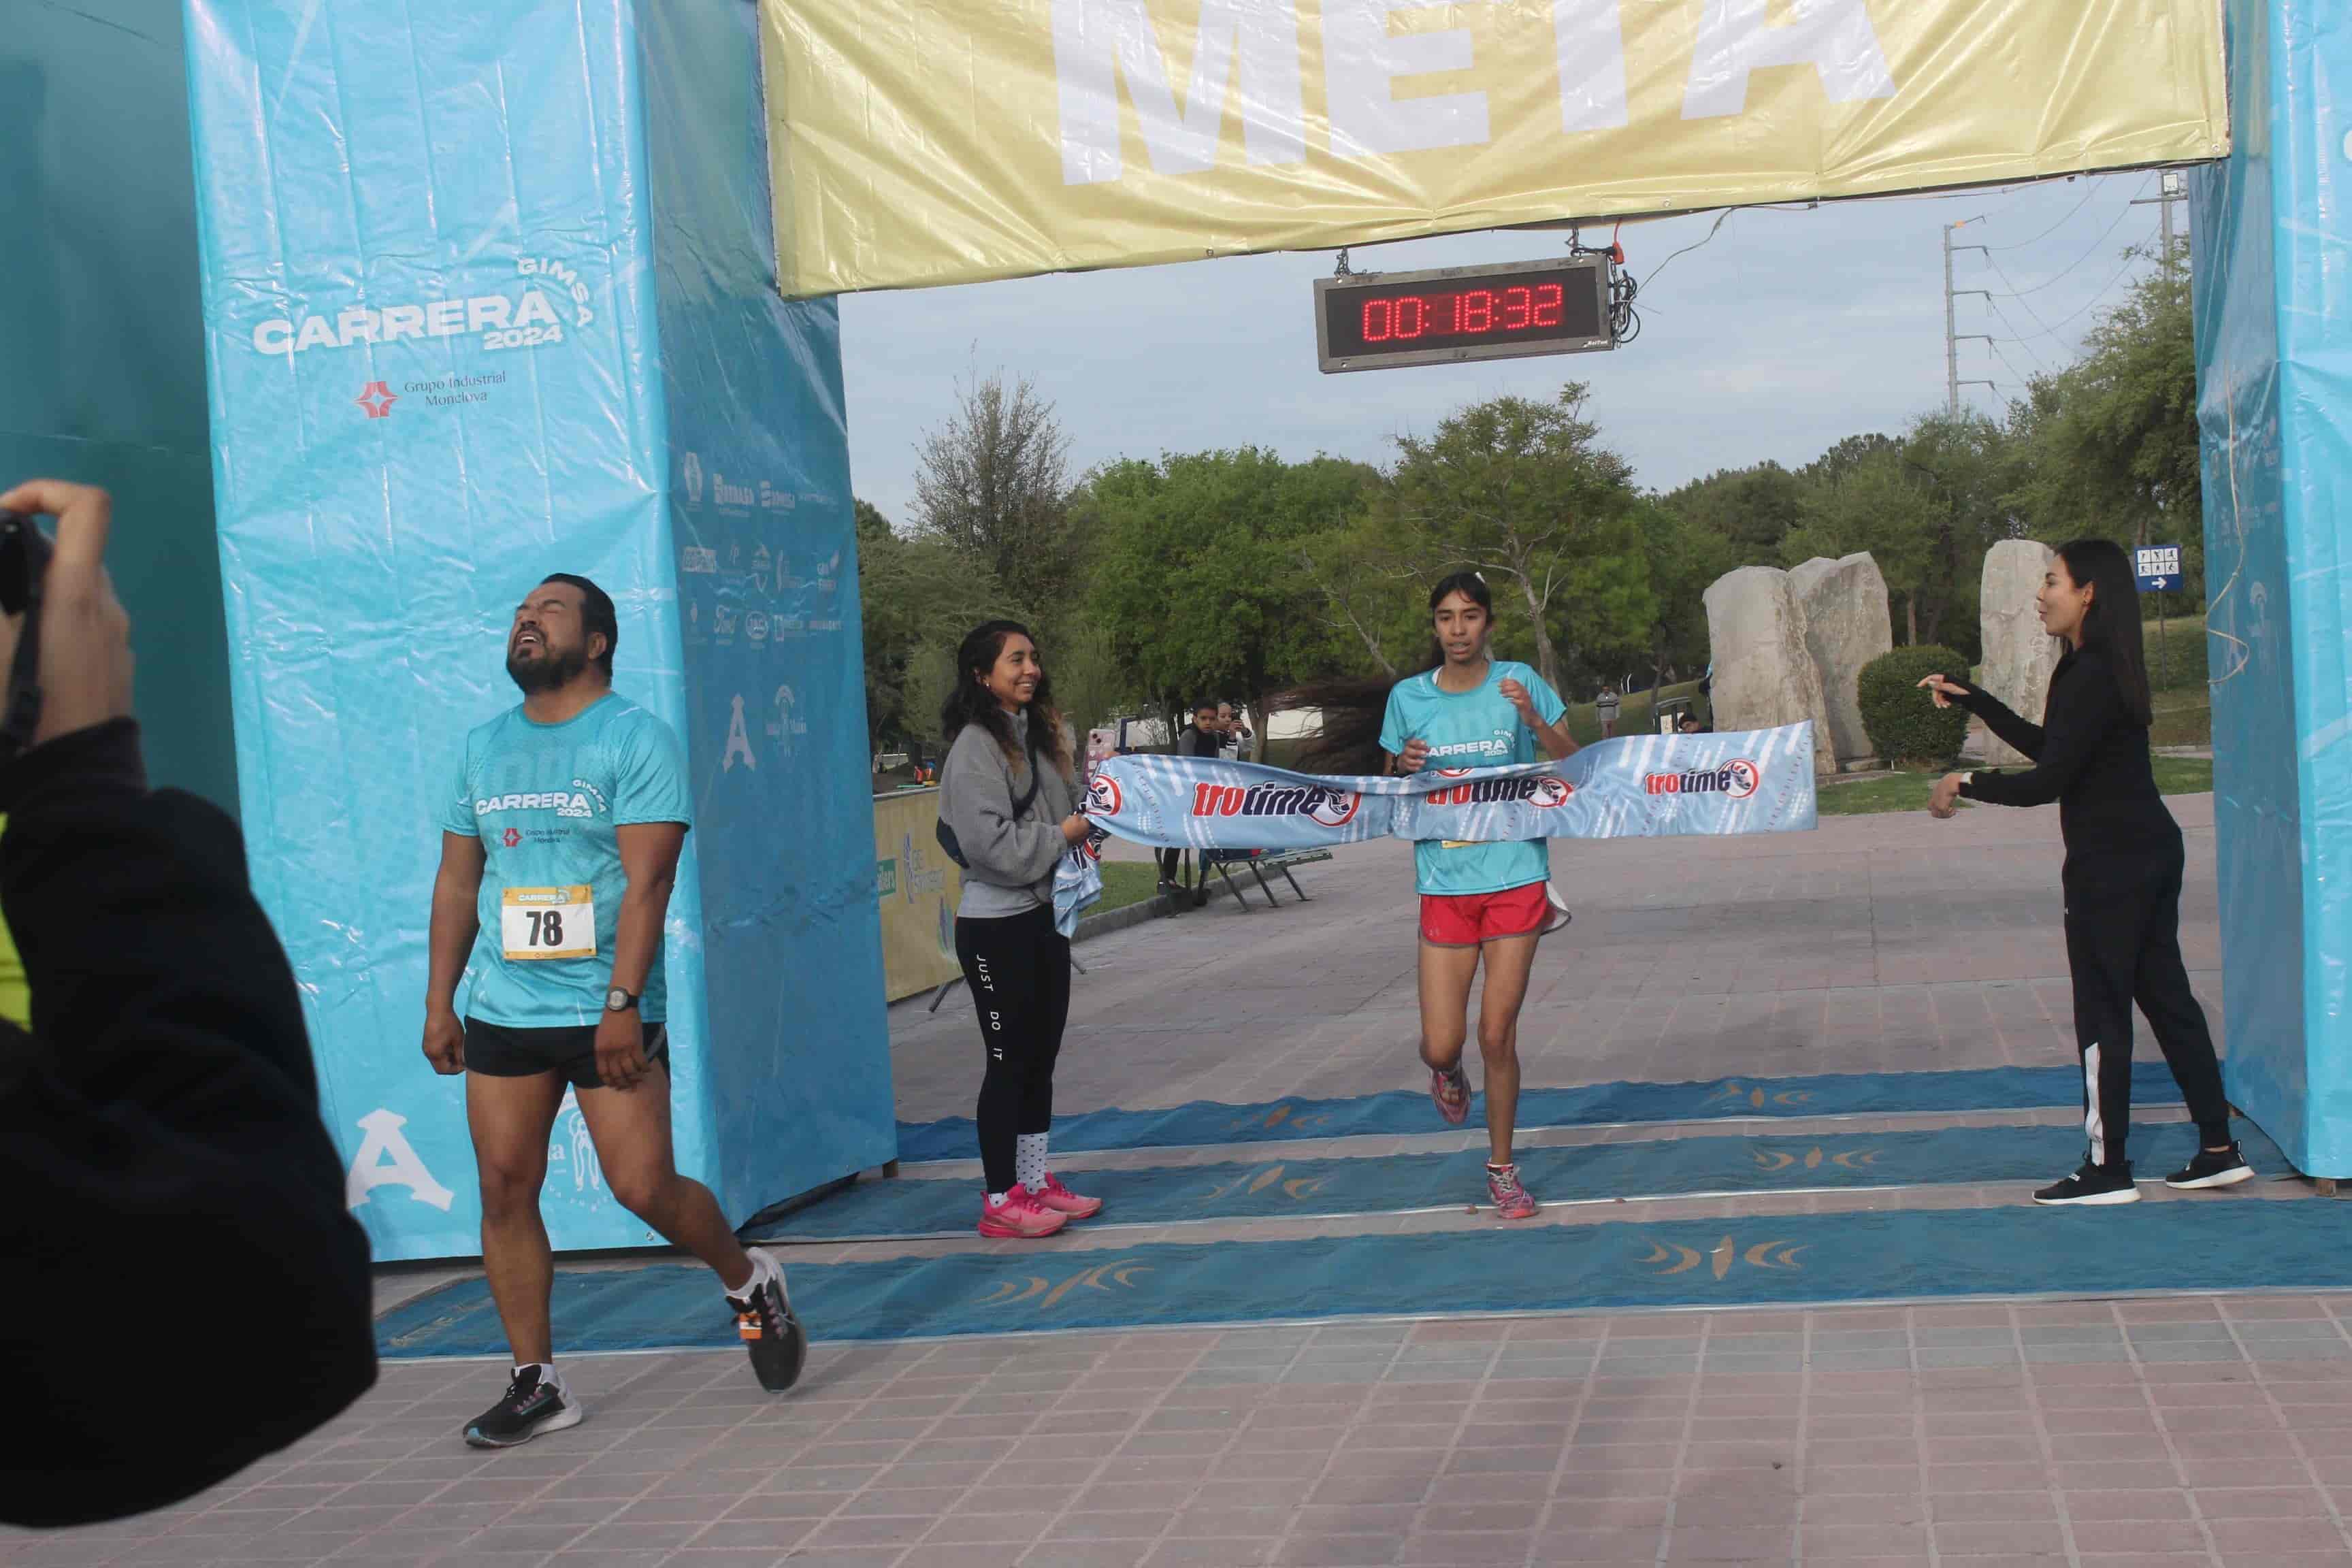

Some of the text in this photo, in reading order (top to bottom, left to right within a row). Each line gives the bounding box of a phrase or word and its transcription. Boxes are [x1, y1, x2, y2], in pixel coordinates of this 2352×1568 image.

[517, 257, 593, 327] GIMSA
[252, 290, 561, 355] CARRERA
[1363, 284, 1563, 342] 00:18:32
[484, 325, 564, 350] 2024
[404, 370, 506, 394] Grupo Industrial
[425, 391, 488, 406] Monclova
[1426, 739, 1508, 757] ARRERA
[1646, 768, 1731, 795] trotime
[476, 791, 591, 816] CARRERA
[557, 808, 593, 817] 2024
[1192, 781, 1327, 817] trotime
[526, 910, 564, 947] 78
[976, 953, 1002, 1061] JUST DO IT
